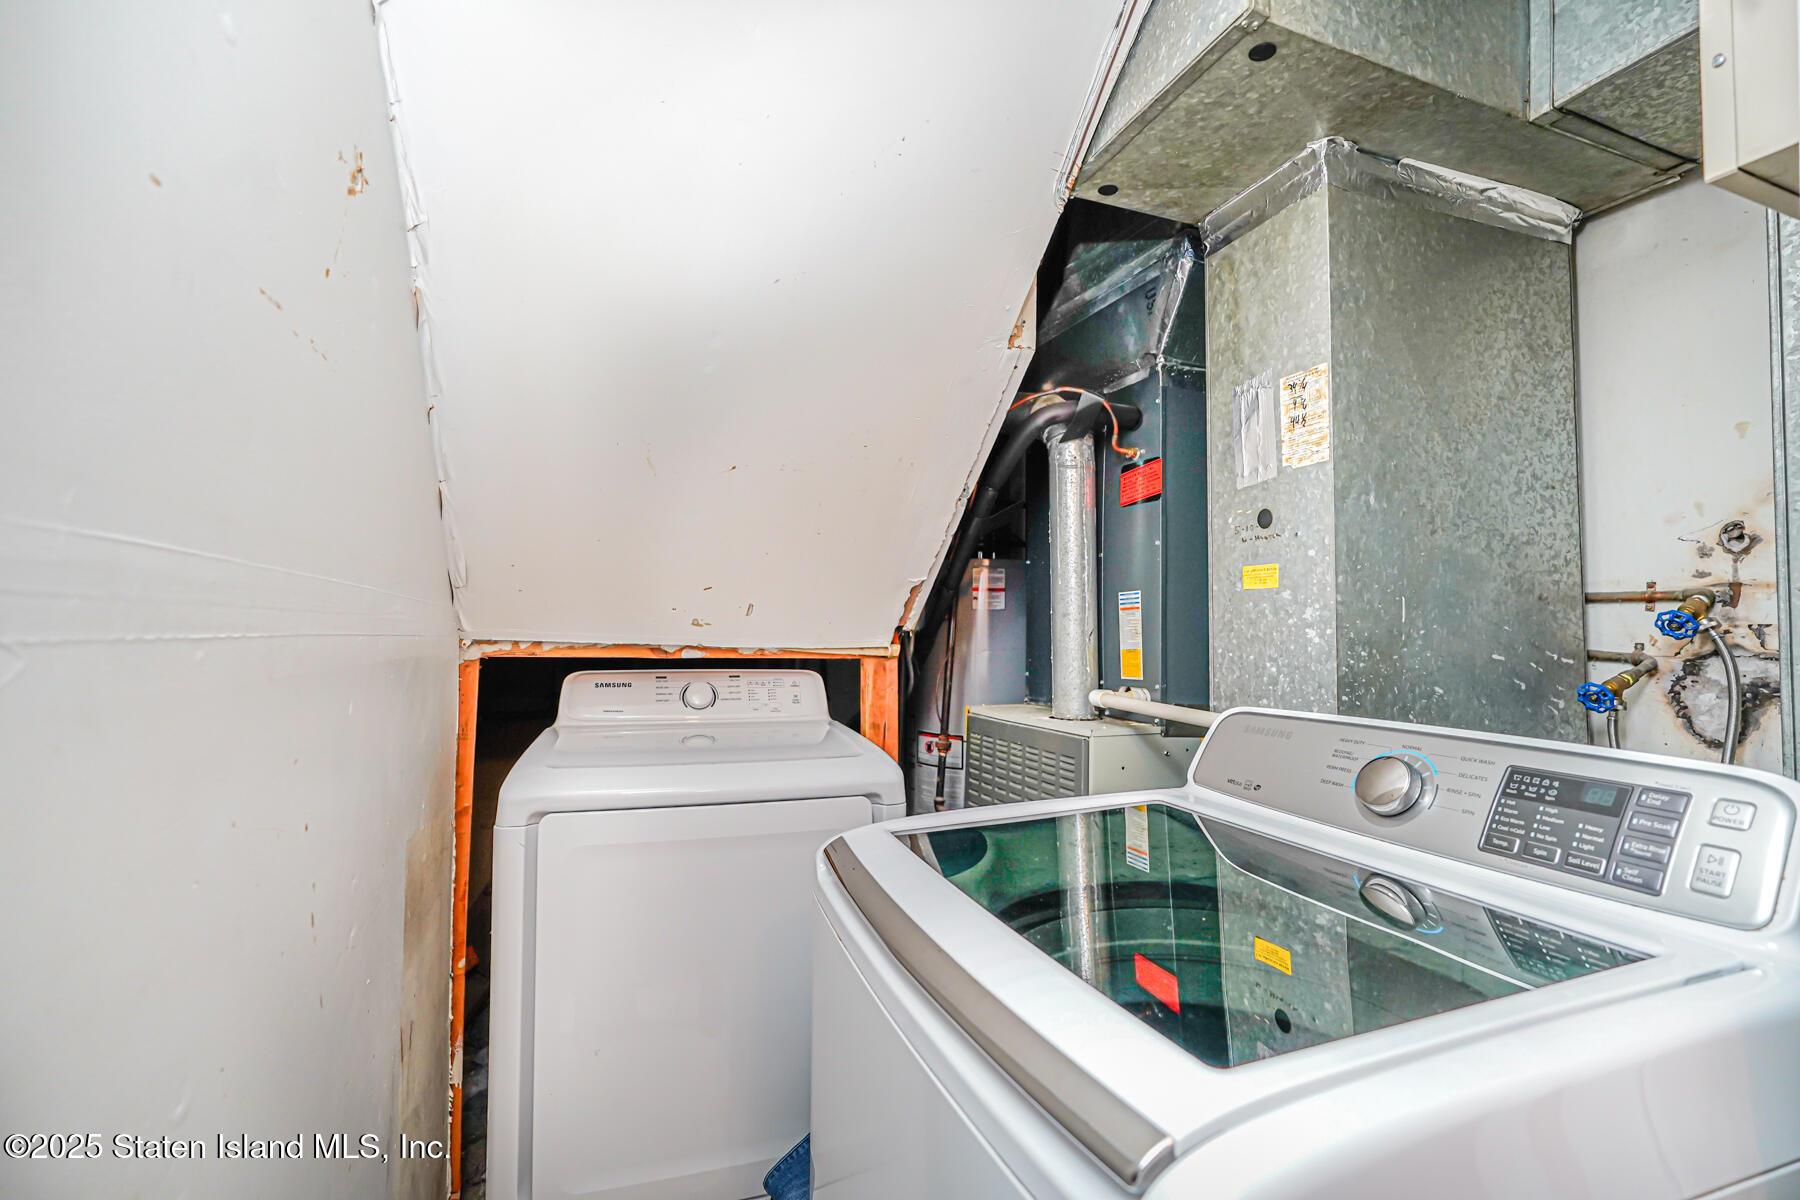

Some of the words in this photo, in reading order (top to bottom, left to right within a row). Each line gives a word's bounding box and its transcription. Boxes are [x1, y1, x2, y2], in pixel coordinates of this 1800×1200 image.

[1243, 724, 1294, 740] SAMSUNG
[1458, 772, 1488, 782] DELICATES
[1649, 791, 1670, 802] Delay
[1542, 815, 1565, 824] Medium
[1639, 817, 1652, 827] Pre
[1653, 820, 1672, 830] Soak
[1713, 815, 1745, 826] POWER
[1581, 833, 1605, 843] Normal
[1533, 847, 1548, 857] Spin
[1578, 842, 1595, 851] Light
[1567, 856, 1581, 865] Soil
[1581, 858, 1601, 870] Level
[1623, 867, 1639, 875] Self
[1699, 867, 1727, 879] START
[1695, 876, 1723, 888] PAUSE
